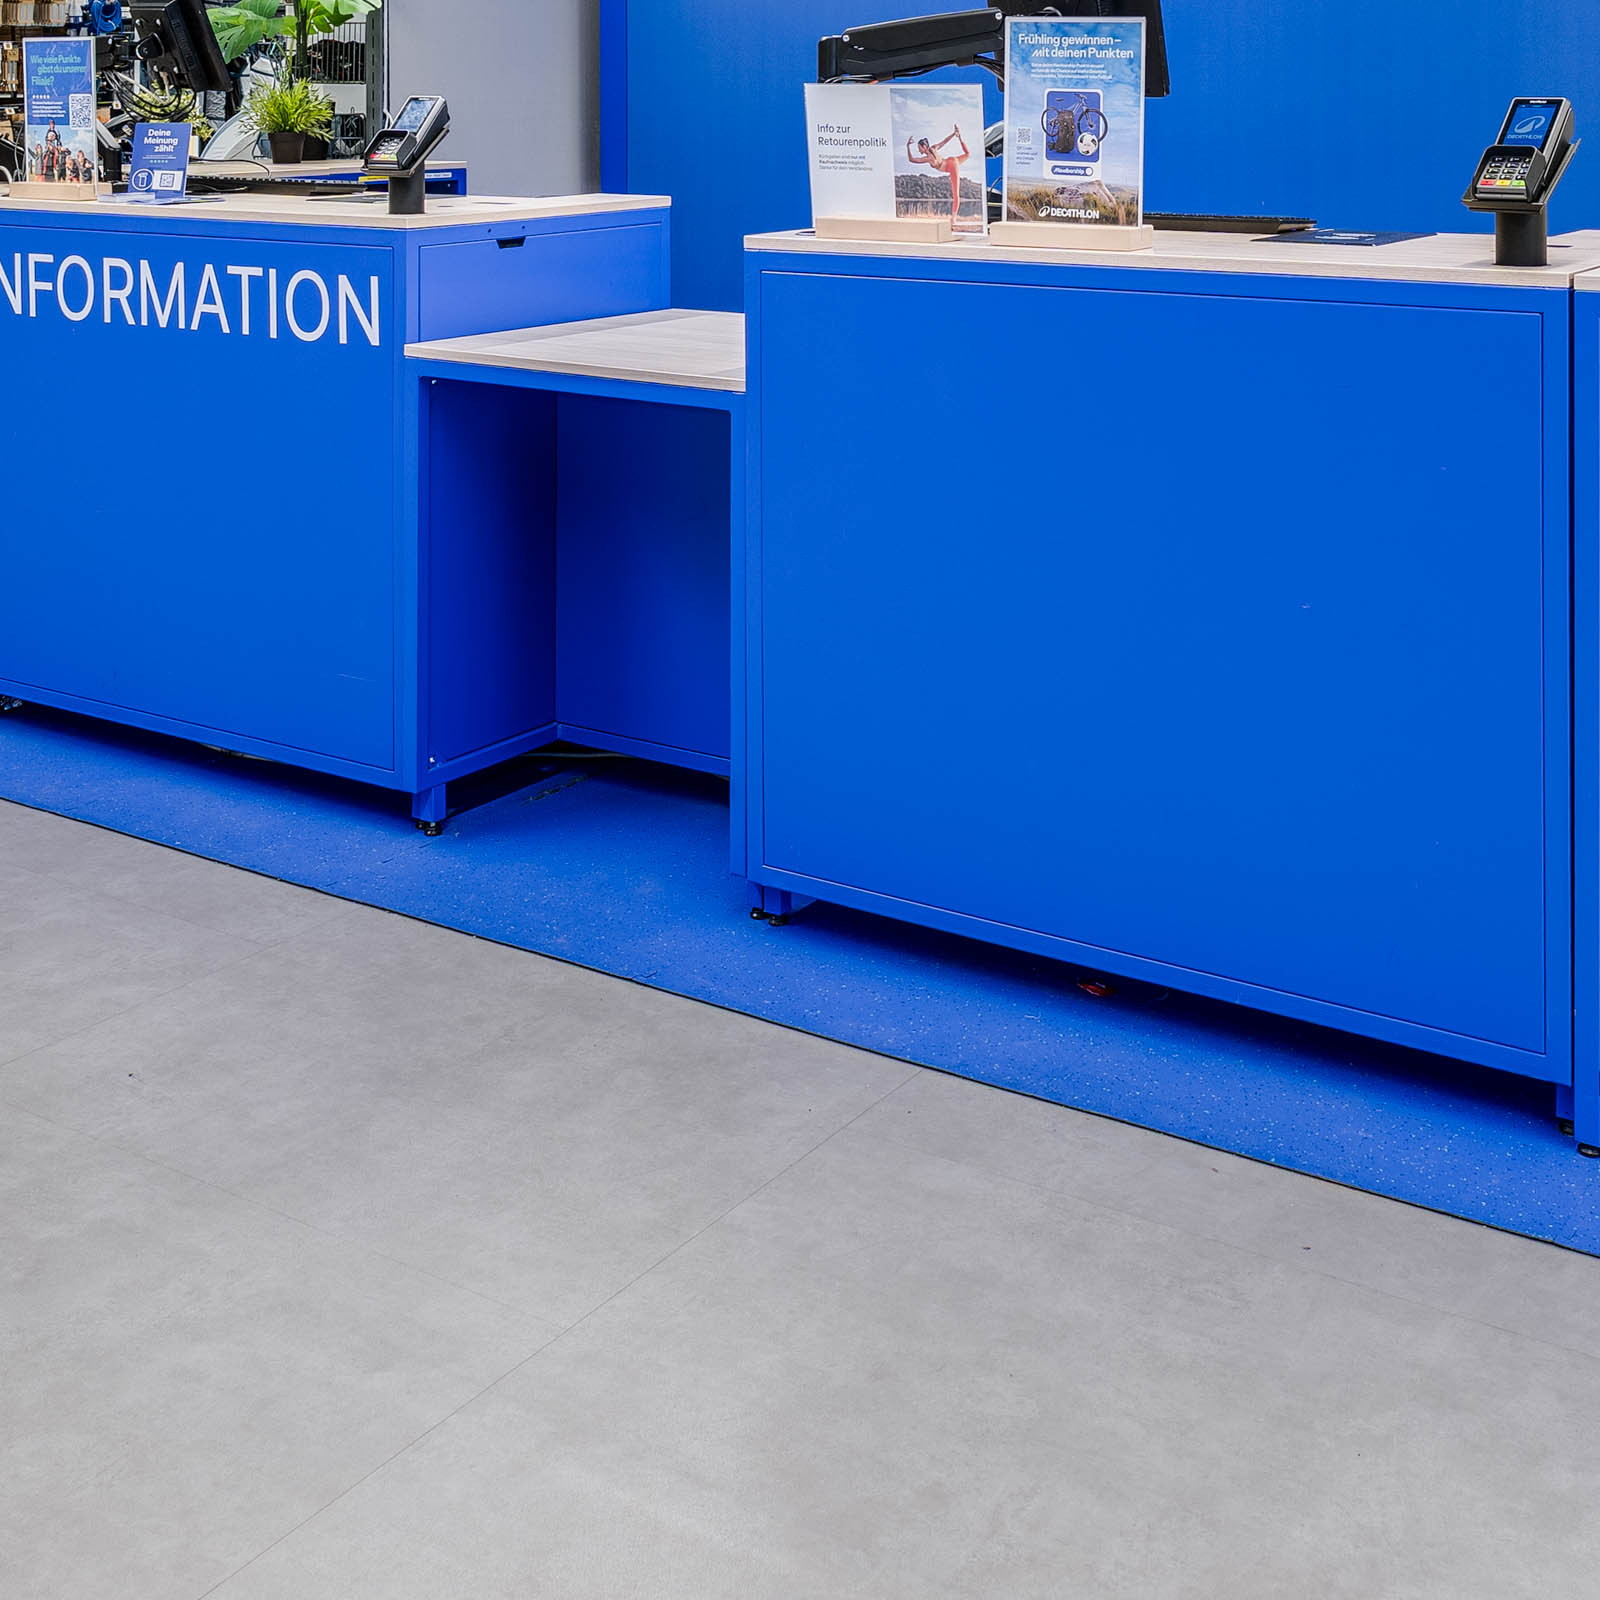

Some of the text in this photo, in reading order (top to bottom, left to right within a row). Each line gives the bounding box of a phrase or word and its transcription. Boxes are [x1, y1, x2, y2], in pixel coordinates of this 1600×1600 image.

[1018, 33, 1060, 47] Frühling
[1061, 34, 1113, 47] gewinnen
[1051, 47, 1087, 58] deinen
[1088, 48, 1134, 59] Punkten
[30, 55, 43, 64] Wie
[58, 55, 81, 64] Punkte
[148, 128, 172, 137] Deine
[817, 123, 835, 133] Info
[143, 137, 178, 145] Meinung
[817, 136, 887, 148] Retourenpolitik
[1050, 207, 1100, 219] DECATHLON
